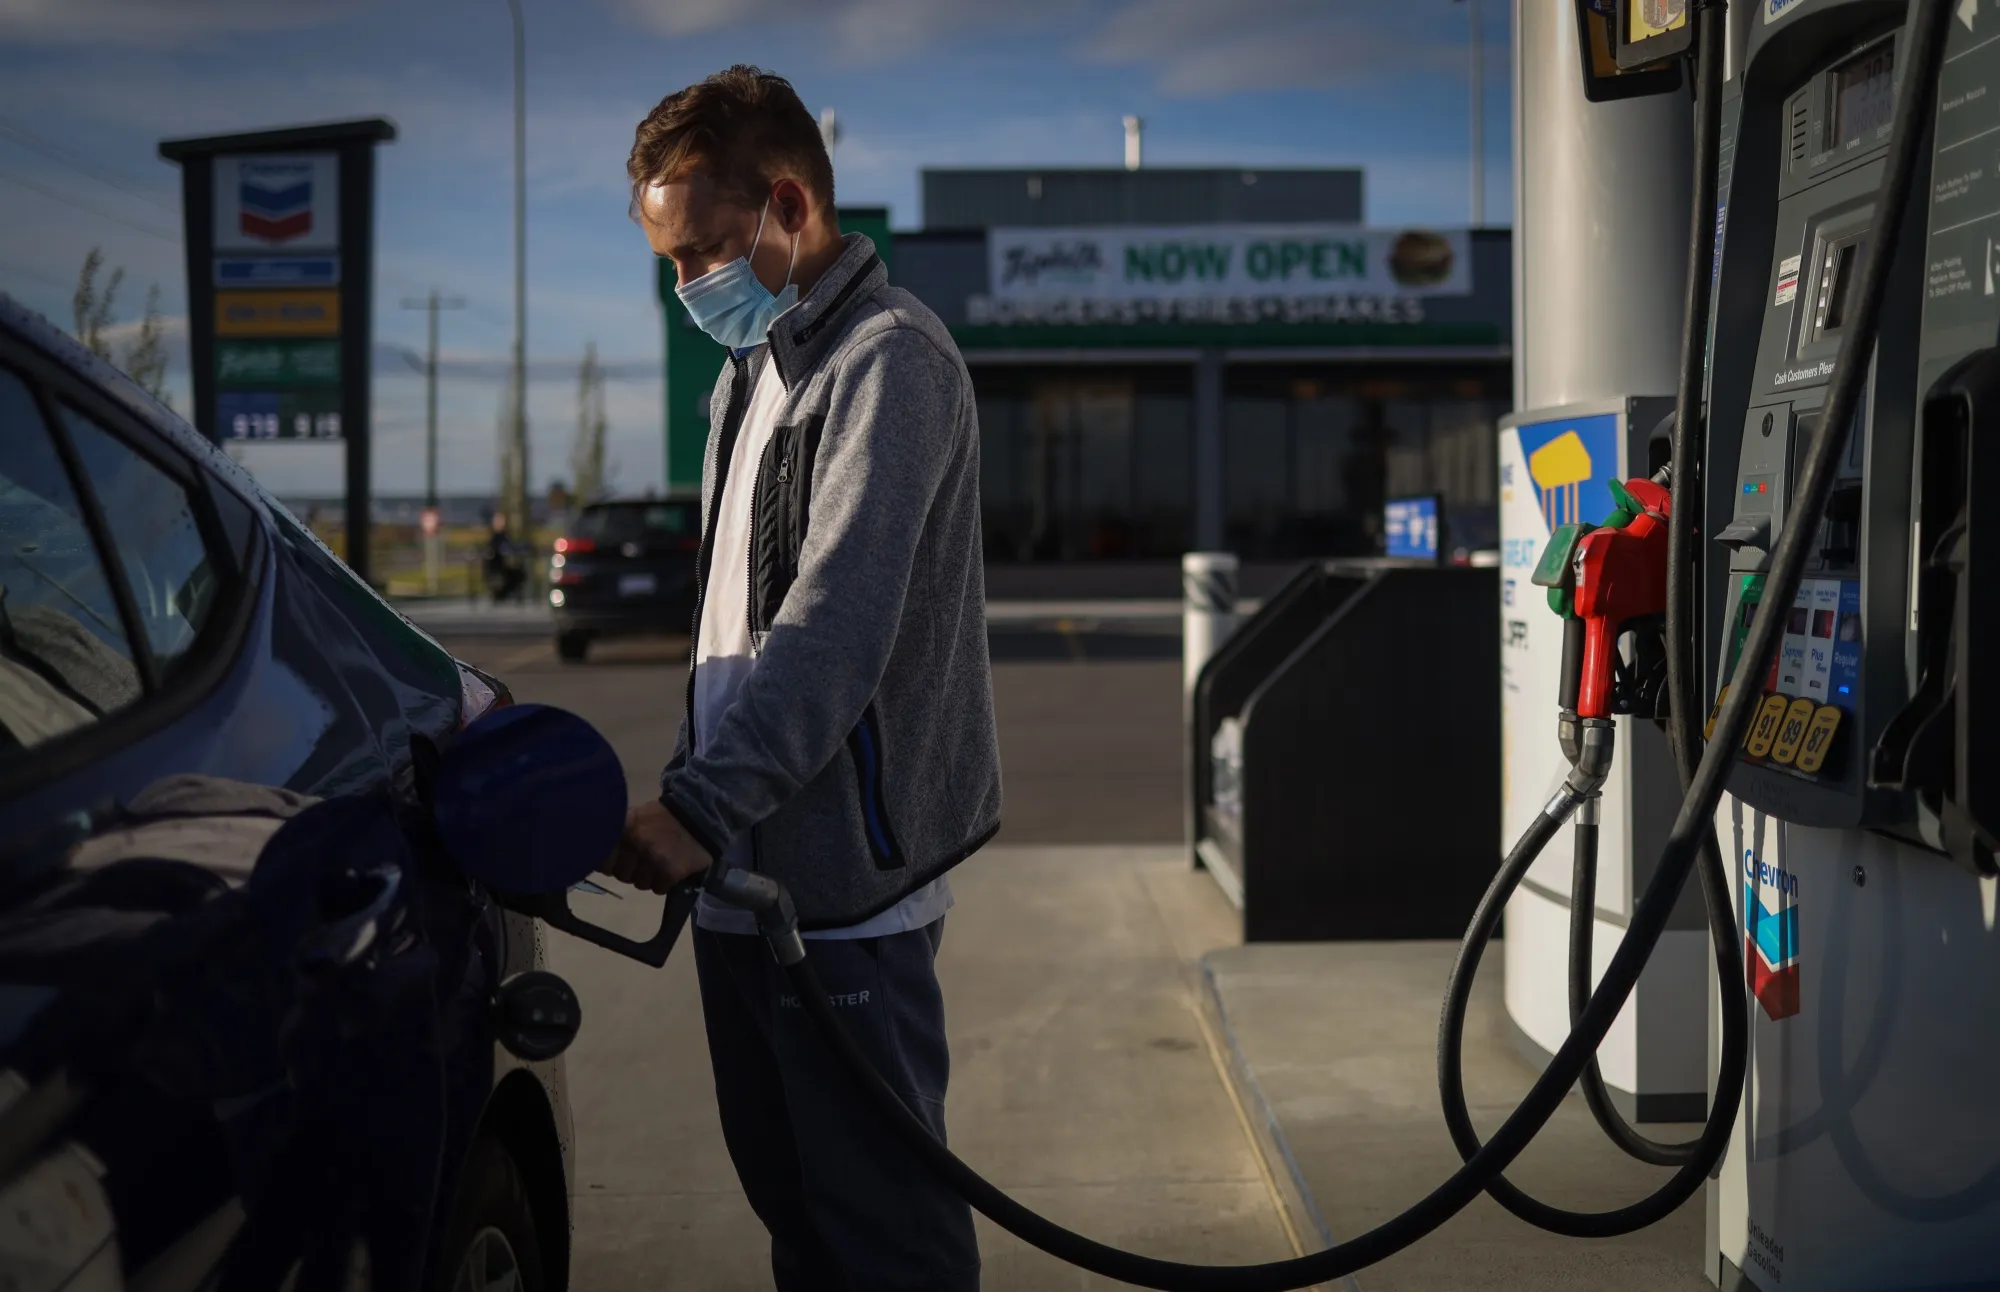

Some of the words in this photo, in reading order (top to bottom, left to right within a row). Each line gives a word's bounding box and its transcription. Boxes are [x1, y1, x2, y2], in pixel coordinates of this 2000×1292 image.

[1123, 242, 1233, 284] NOW
[1245, 241, 1367, 283] OPEN
[1774, 371, 1787, 386] Cash
[1787, 366, 1818, 383] Customers
[1811, 648, 1824, 661] Plus
[1834, 651, 1858, 668] Regular
[1757, 713, 1776, 741] 91
[1782, 718, 1803, 746] 89
[1806, 725, 1830, 754] 87
[1744, 849, 1799, 899] Chevron
[780, 989, 871, 1009] HOSTER
[1747, 1216, 1784, 1262] Unleaded
[1747, 1240, 1782, 1284] Gasoline
